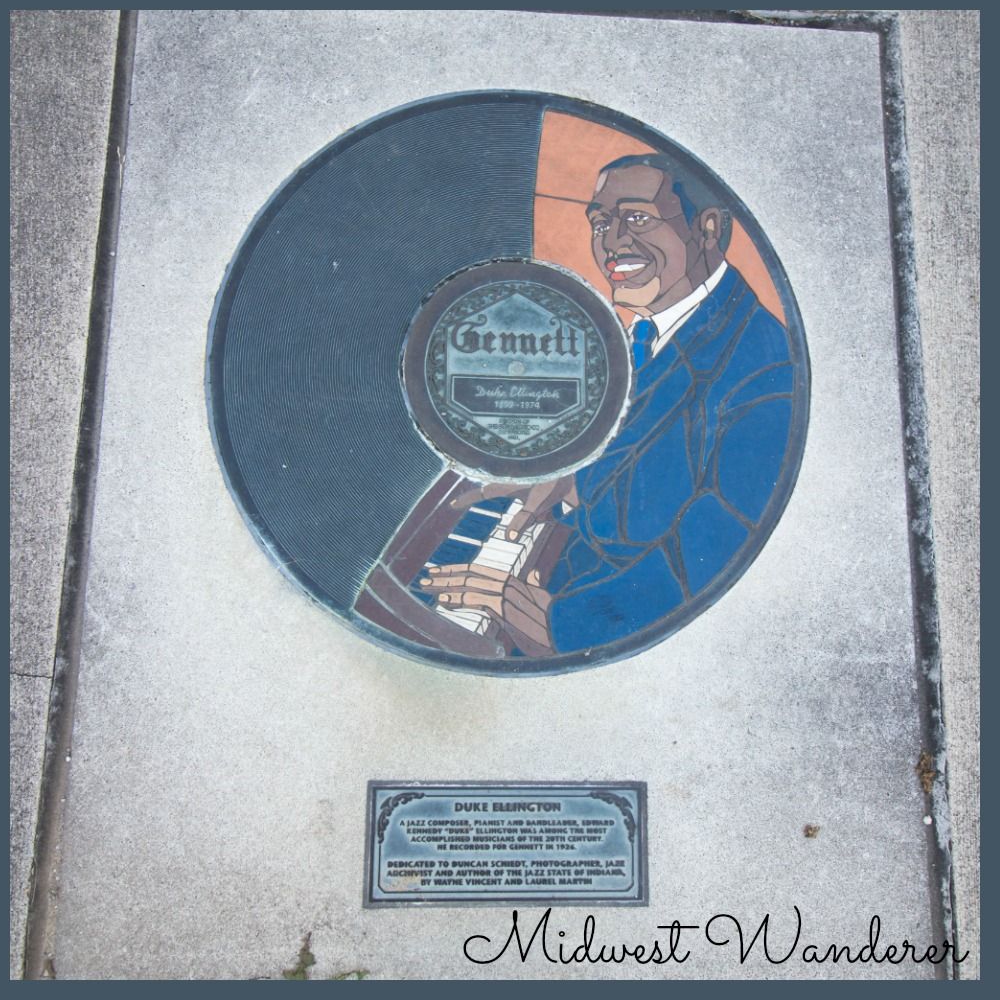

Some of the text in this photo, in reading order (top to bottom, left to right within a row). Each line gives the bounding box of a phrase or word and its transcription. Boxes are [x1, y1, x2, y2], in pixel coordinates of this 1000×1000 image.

[450, 314, 580, 356] Gennett
[454, 802, 562, 812] DUKE ELLINGTON
[406, 820, 426, 828] JAZZ
[428, 820, 472, 828] COMPOSER,
[605, 860, 626, 868] JAZZ
[524, 870, 545, 878] JAZZ
